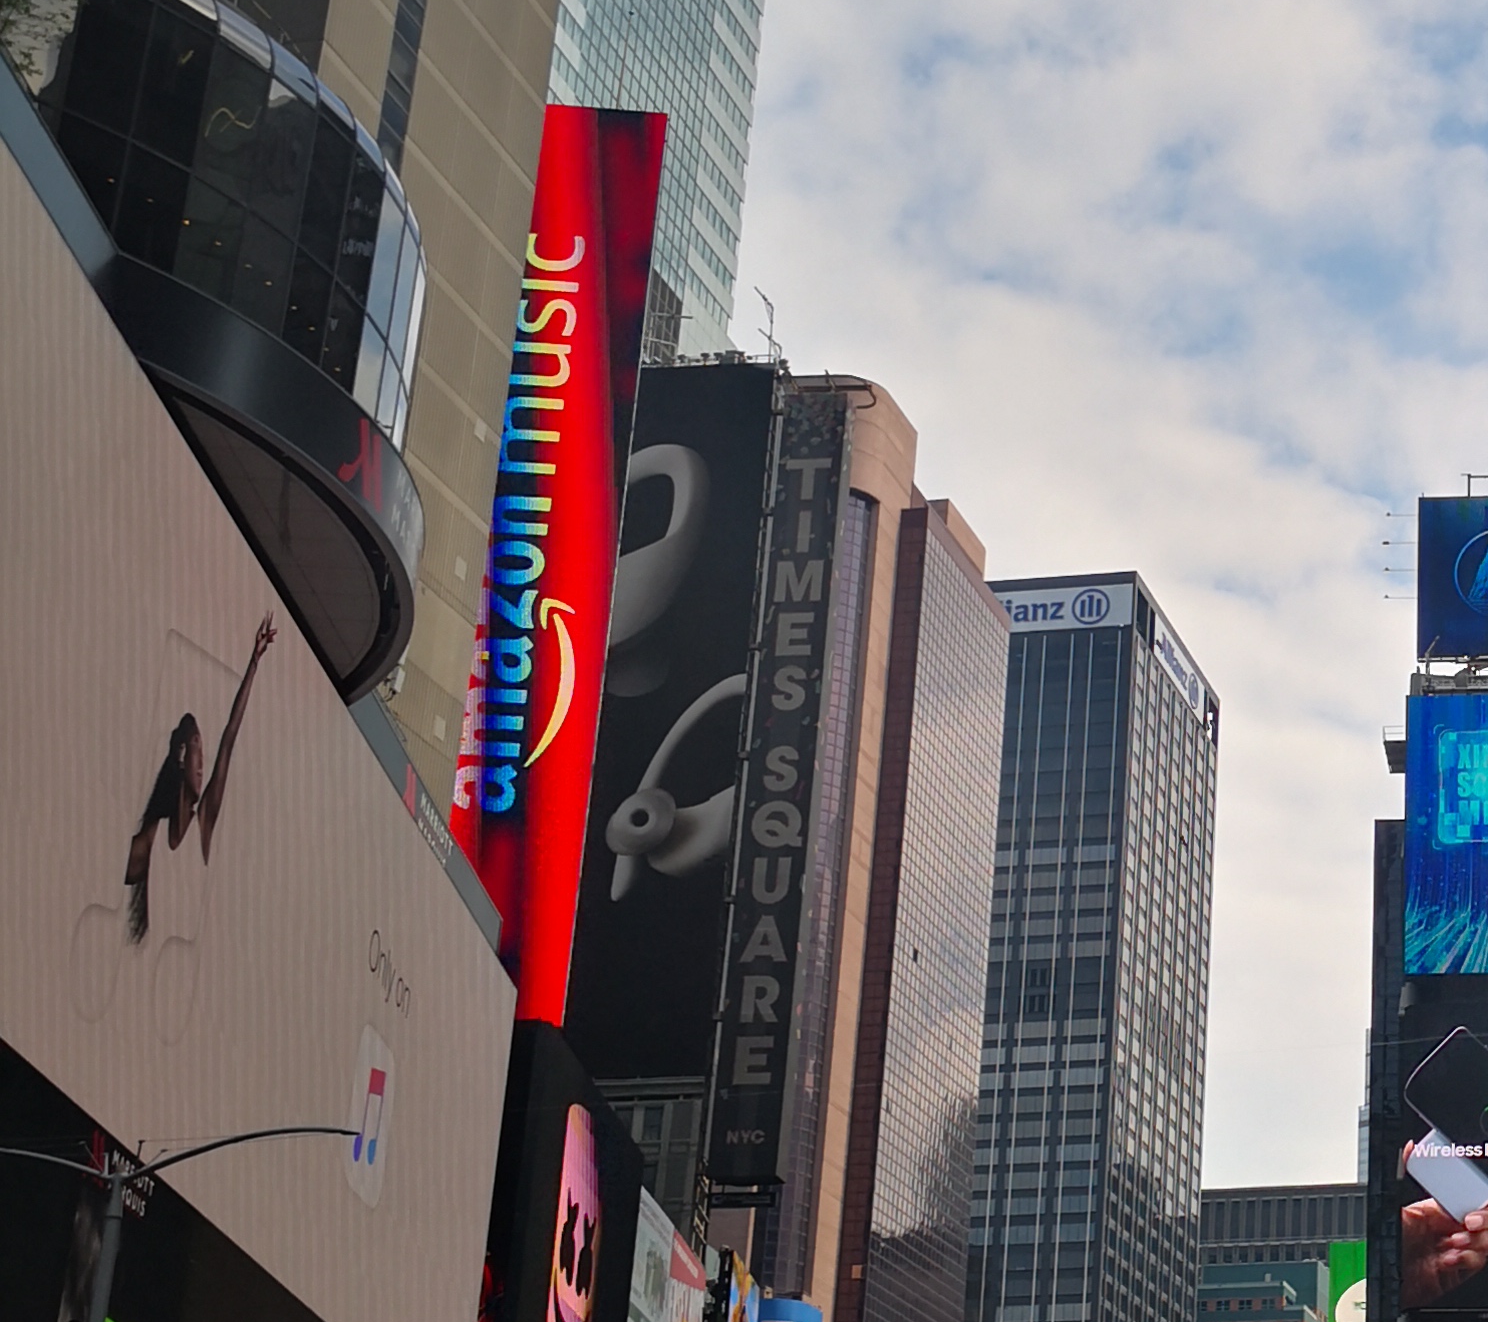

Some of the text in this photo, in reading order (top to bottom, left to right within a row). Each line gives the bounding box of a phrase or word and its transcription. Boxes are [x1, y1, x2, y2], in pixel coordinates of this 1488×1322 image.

[482, 232, 584, 814] amazon music
[769, 457, 832, 712] TIMES
[369, 929, 411, 1019] Only on
[732, 744, 803, 1086] SQUARE
[726, 1128, 766, 1146] NYC
[1414, 1143, 1484, 1159] Wireless
